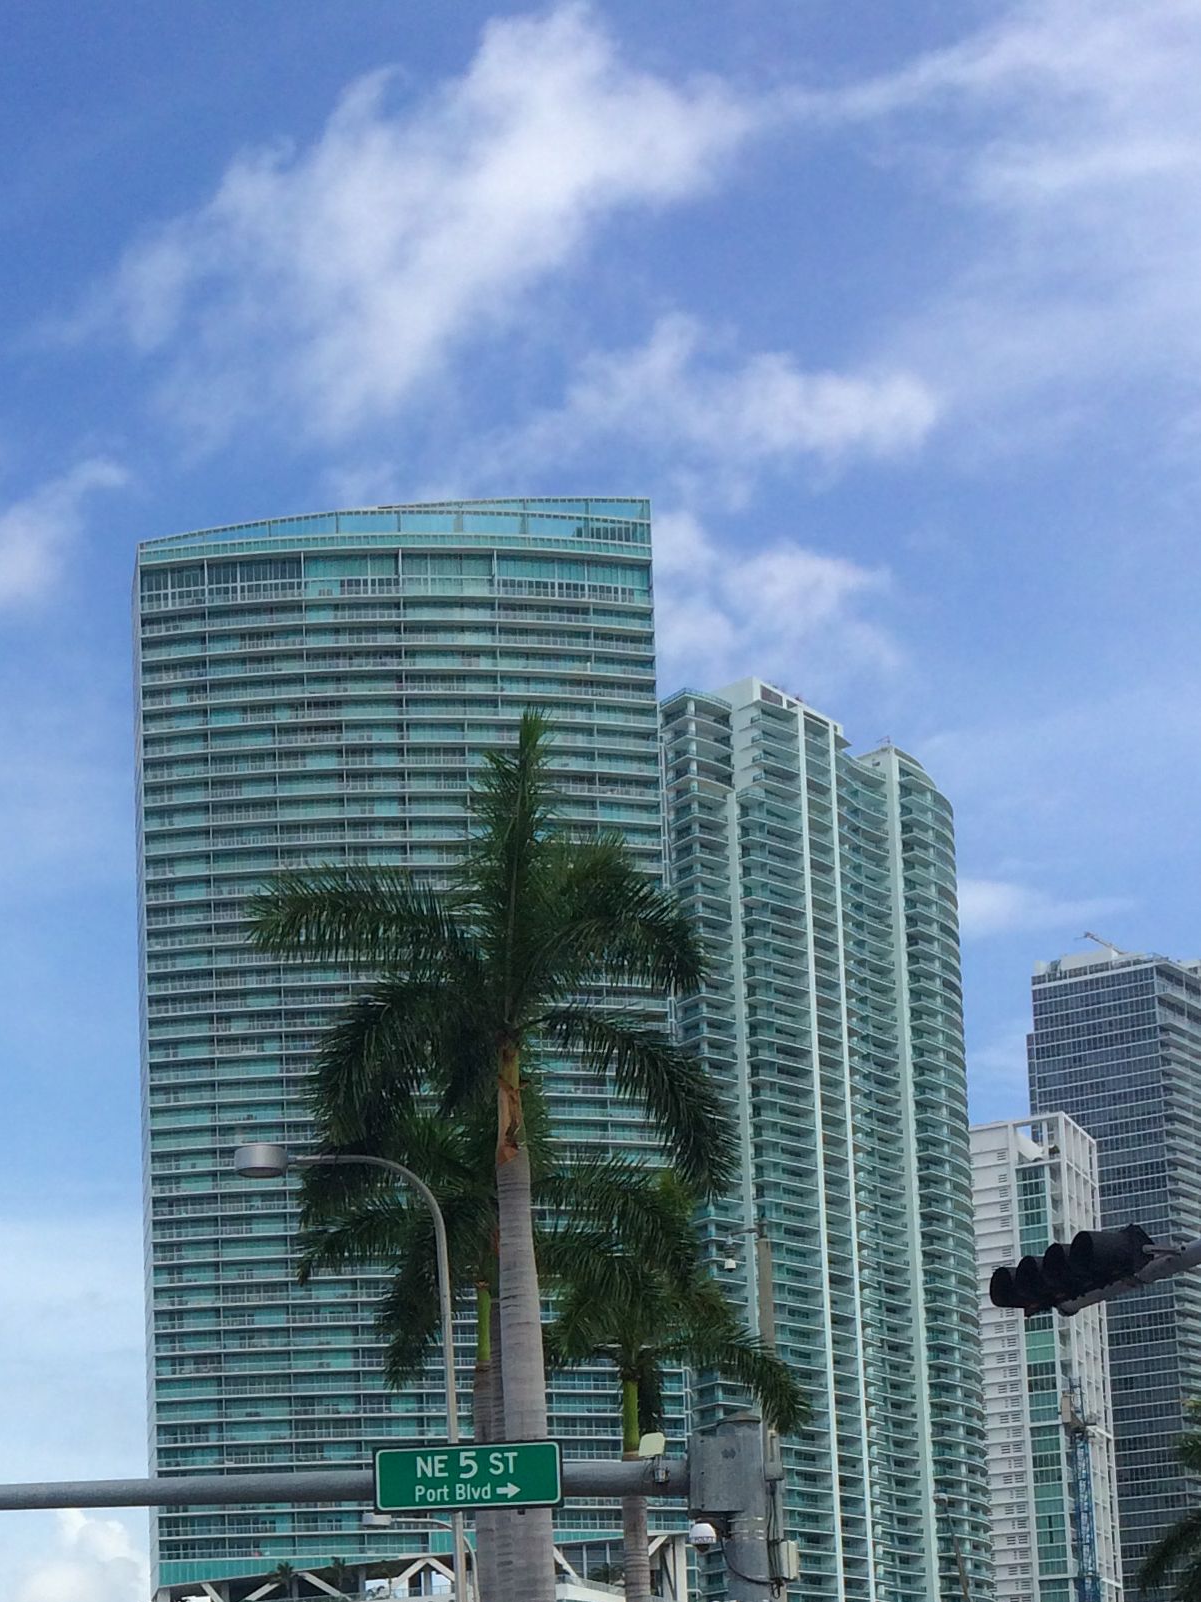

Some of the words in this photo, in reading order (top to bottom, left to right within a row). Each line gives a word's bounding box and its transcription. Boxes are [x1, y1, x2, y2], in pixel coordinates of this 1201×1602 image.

[416, 1455, 449, 1478] NE
[459, 1451, 478, 1479] 5
[489, 1452, 518, 1475] ST
[415, 1485, 449, 1502] Port
[455, 1482, 491, 1500] Blvd
